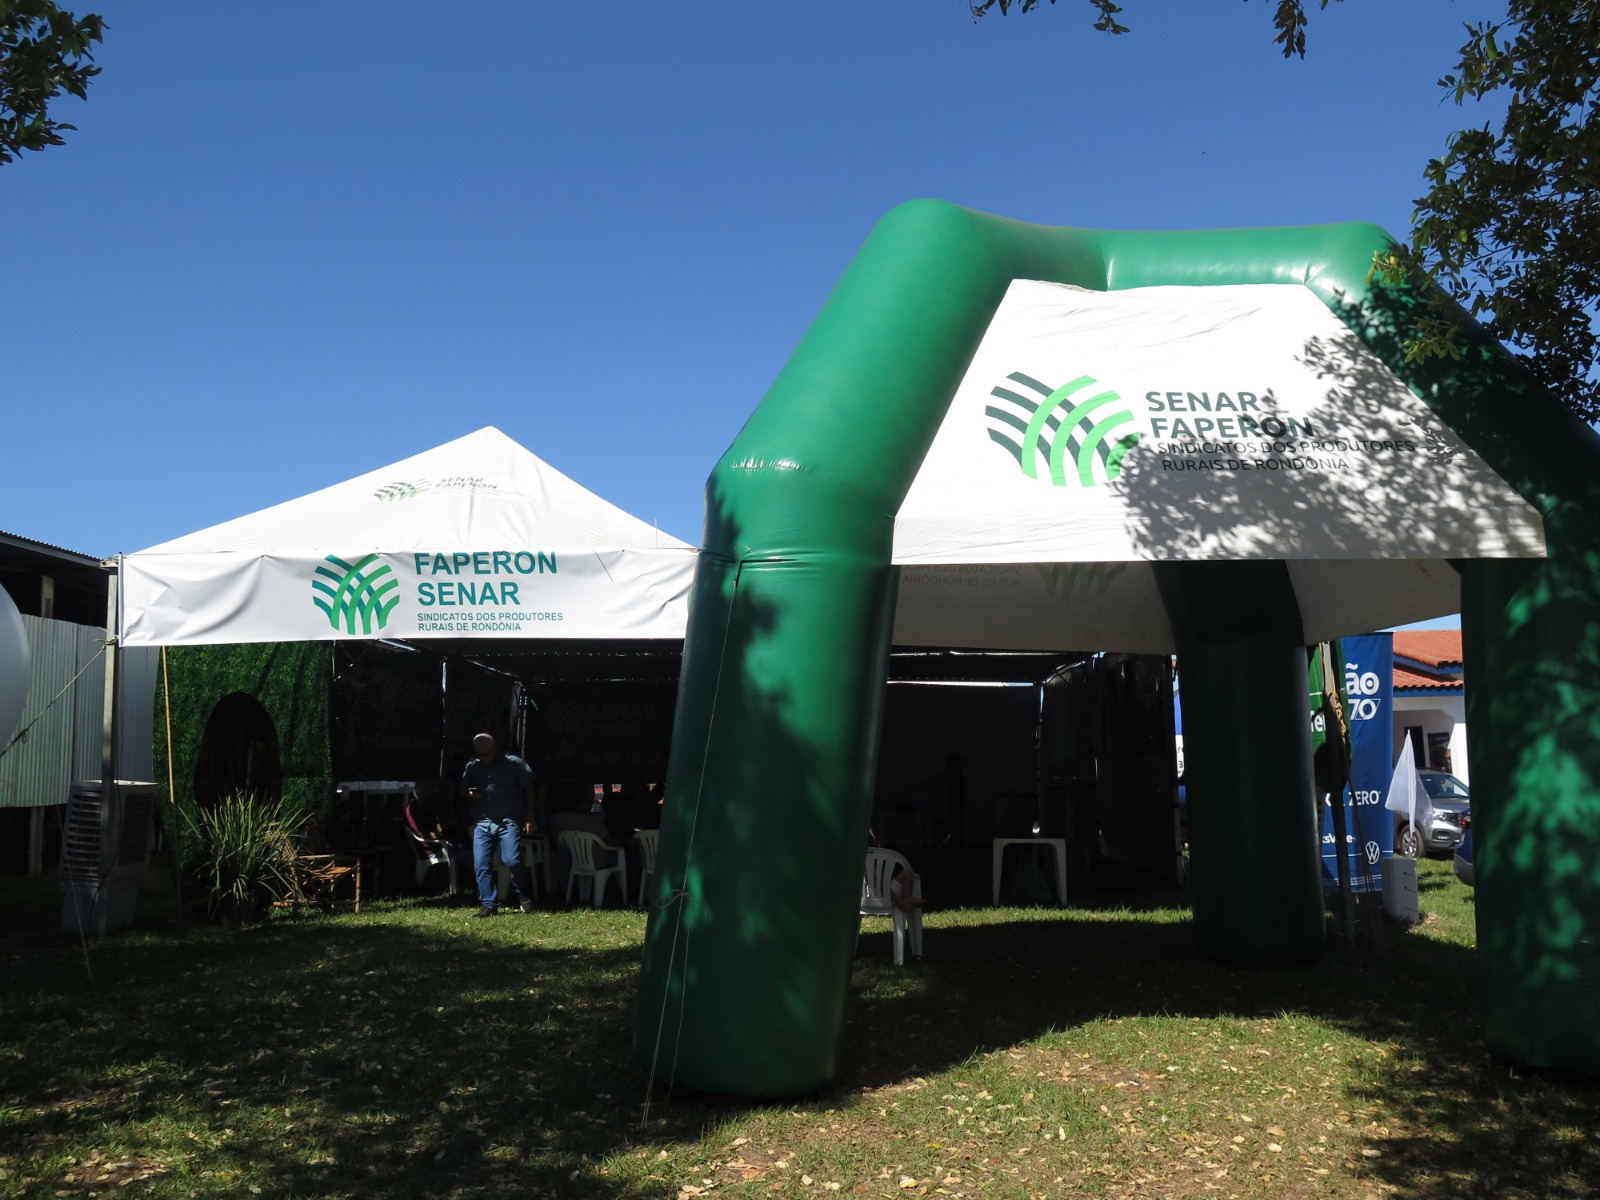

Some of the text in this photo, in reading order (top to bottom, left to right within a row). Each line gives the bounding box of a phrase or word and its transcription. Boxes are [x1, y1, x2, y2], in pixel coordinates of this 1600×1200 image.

[1145, 391, 1262, 412] SENAR
[1150, 416, 1315, 438] FAPERON
[1157, 440, 1416, 455] SINDICATOS DOS PRODUTORES
[1163, 455, 1350, 471] RURAIS DE RONDÔNIA
[414, 551, 557, 575] FAPERON
[417, 582, 520, 606] SENAR
[417, 612, 563, 622] SINDICATOS DOS PRODUTORES
[418, 620, 521, 632] RURAIS DE RONDÔNIA
